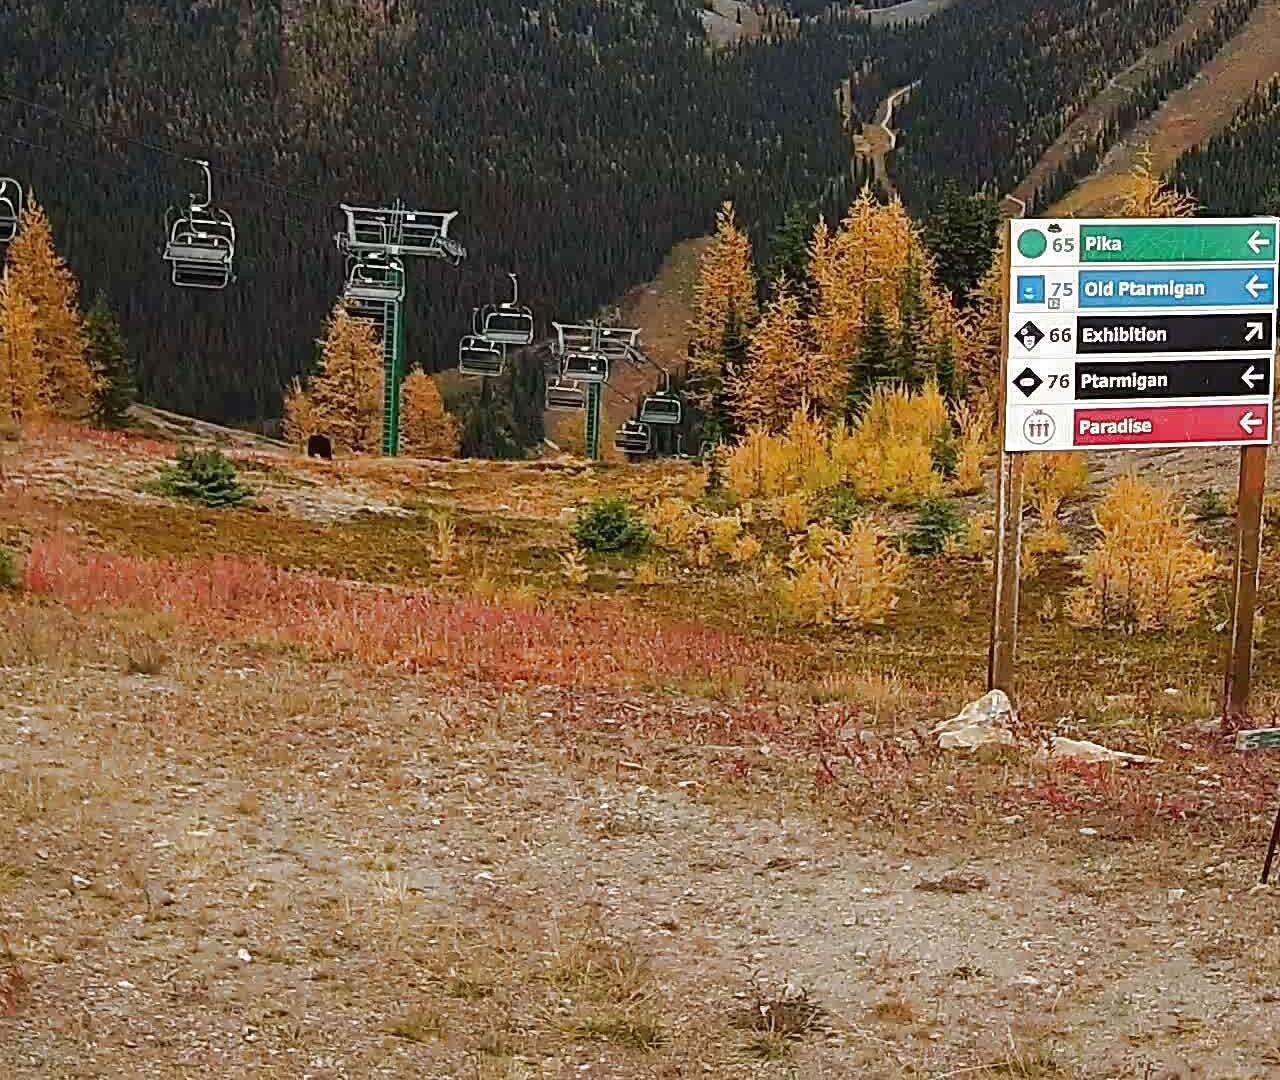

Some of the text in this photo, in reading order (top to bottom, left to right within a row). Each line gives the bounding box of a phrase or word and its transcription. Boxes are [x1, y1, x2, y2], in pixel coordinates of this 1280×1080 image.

[1052, 235, 1122, 253] 65 Pika
[1051, 281, 1204, 298] 75 Old Ptarmigan
[1049, 326, 1167, 343] 66 Exhibition
[1047, 372, 1167, 390] 76 Ptarmigan
[1079, 417, 1152, 435] Paradise
